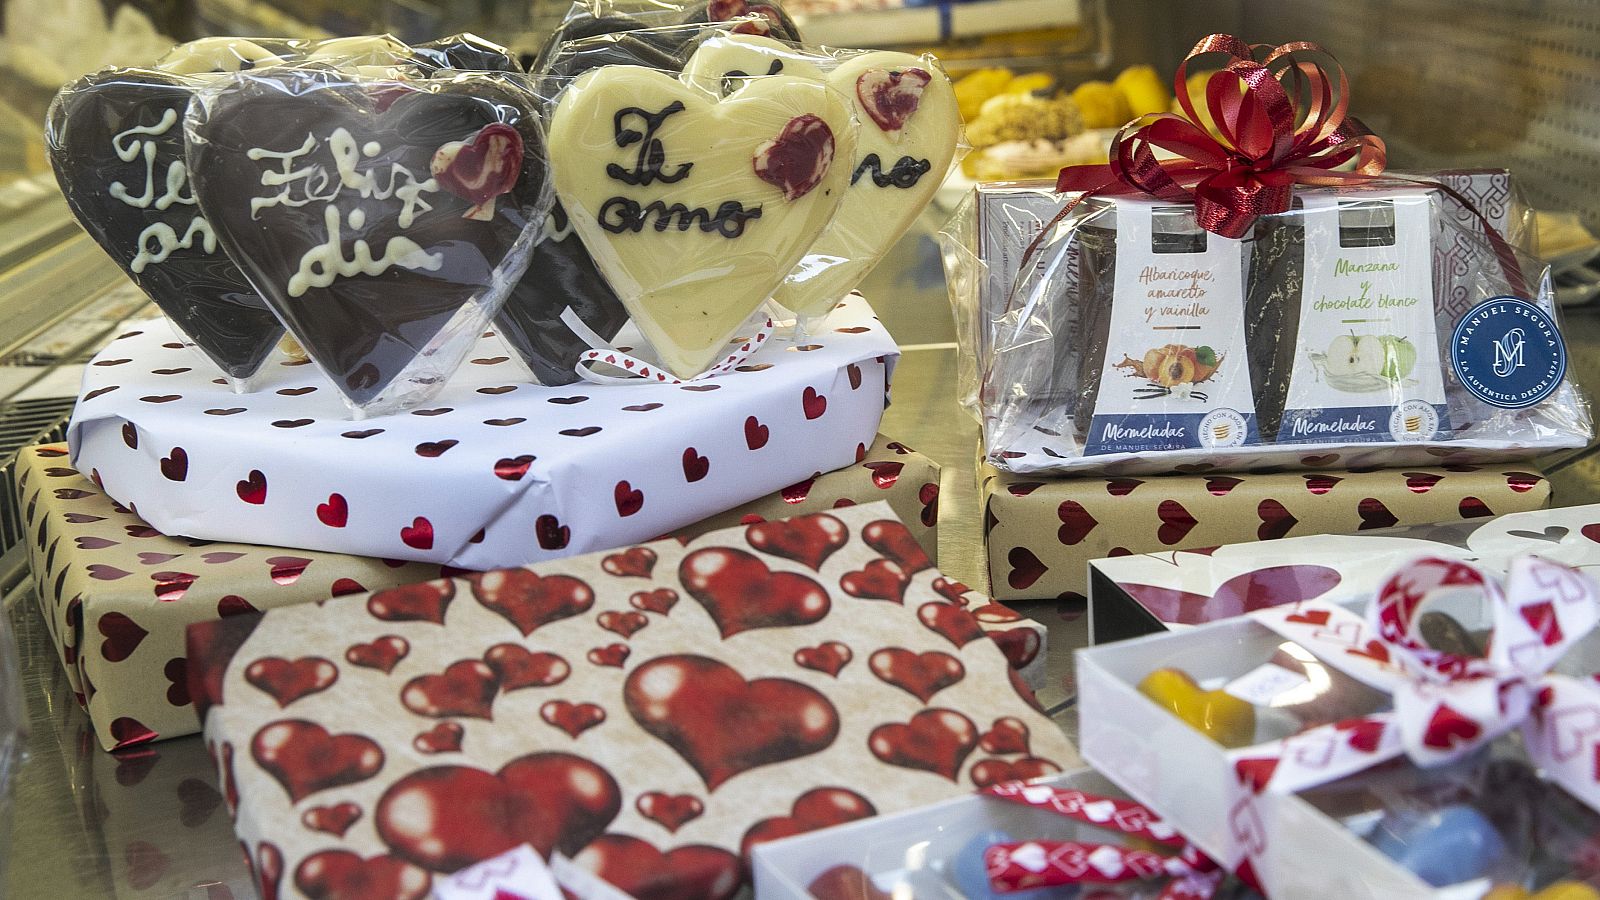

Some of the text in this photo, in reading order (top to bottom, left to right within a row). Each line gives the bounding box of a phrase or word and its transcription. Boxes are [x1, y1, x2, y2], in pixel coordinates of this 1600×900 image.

[247, 127, 441, 229] Feliz
[599, 196, 764, 239] amo
[1139, 266, 1216, 288] Albaricoque,
[1334, 257, 1399, 277] Manzana
[1147, 285, 1208, 299] amaretto
[1360, 280, 1373, 298] y
[1144, 302, 1210, 323] y vainilla
[1313, 293, 1418, 312] chocolate blanco
[1460, 305, 1556, 347] MANUEL SEGURA
[1460, 361, 1470, 372] LA
[1521, 379, 1548, 399] DESDE
[1546, 360, 1559, 379] 1874
[1212, 412, 1227, 420] CON
[1292, 415, 1376, 436] Mermeladas
[1101, 422, 1186, 442] Mermeladas
